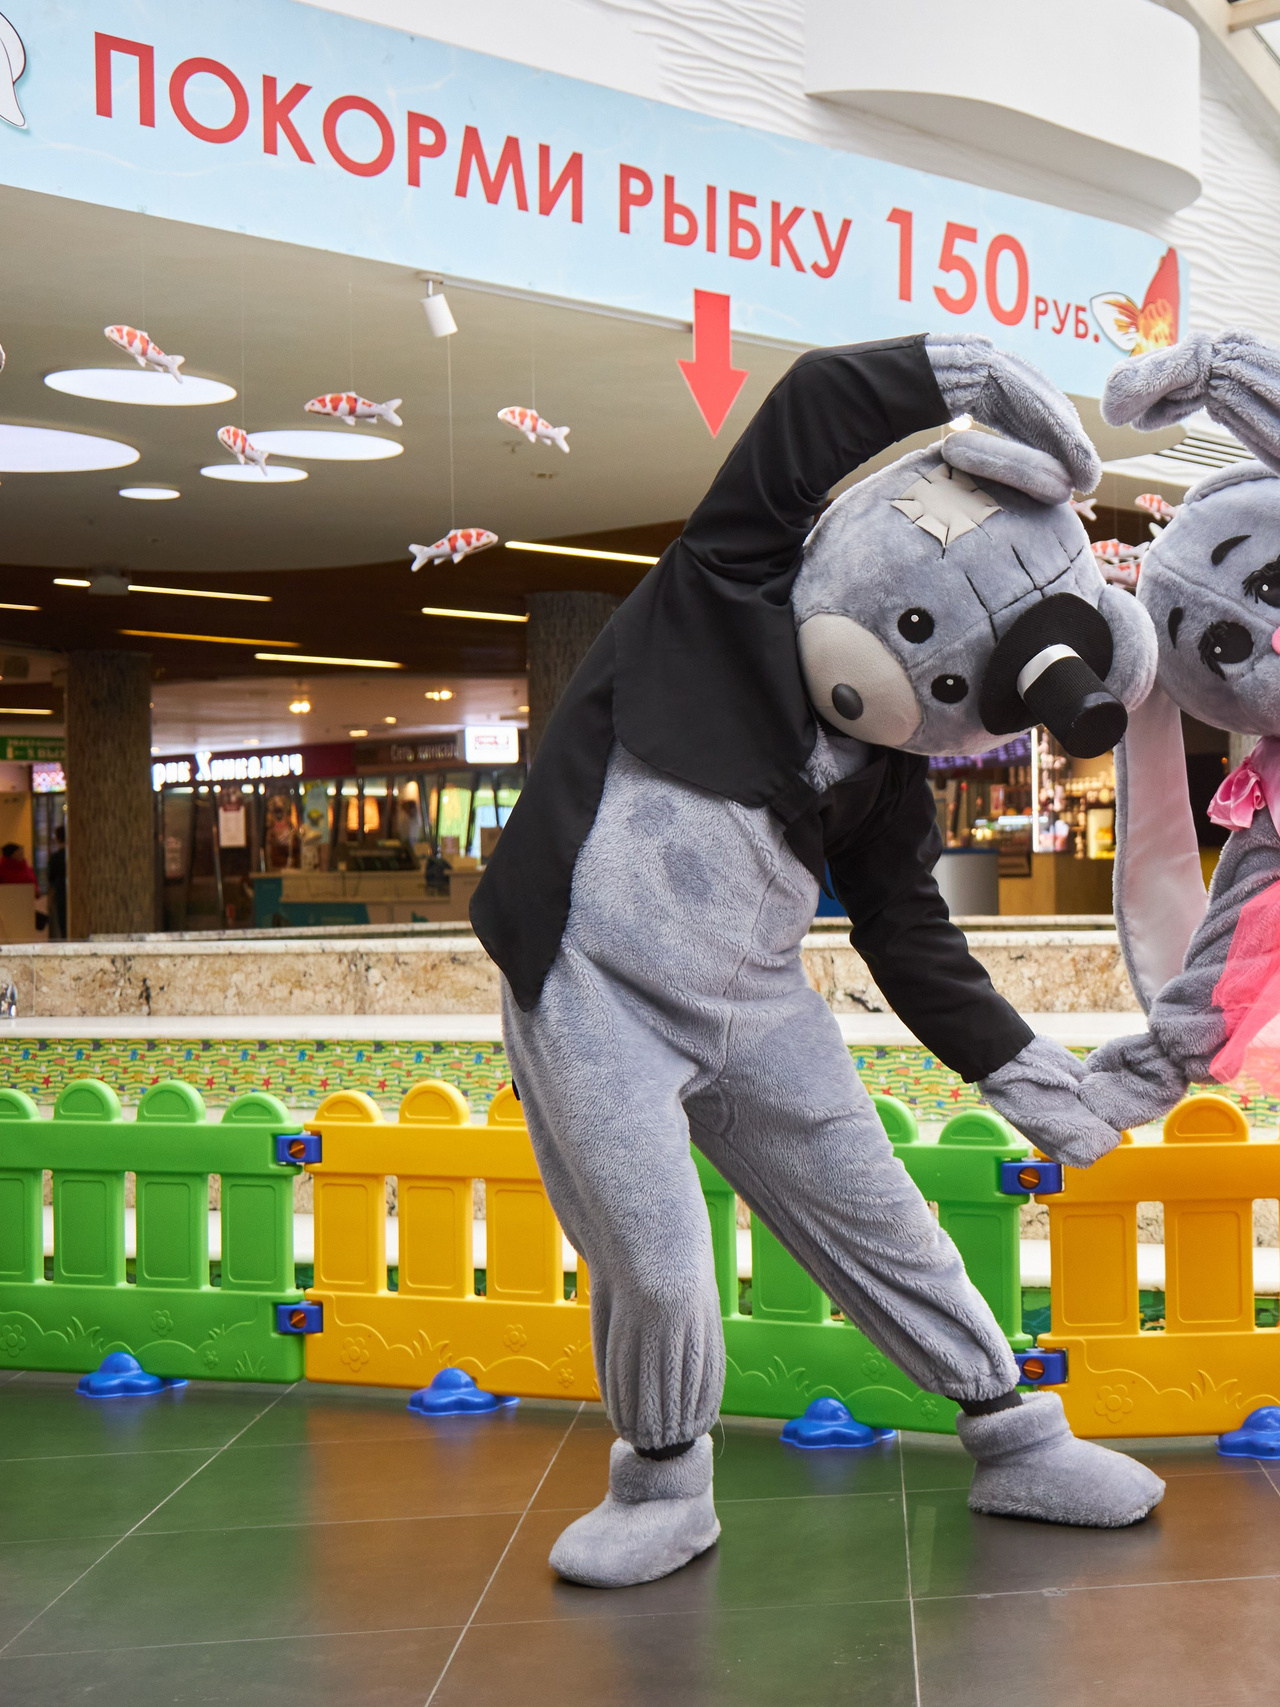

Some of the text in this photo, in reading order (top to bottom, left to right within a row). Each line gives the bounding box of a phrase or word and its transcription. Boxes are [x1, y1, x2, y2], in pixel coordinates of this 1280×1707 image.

[94, 31, 1101, 343] ПОКОРМИ РЫБКУ 150 РУБ.
